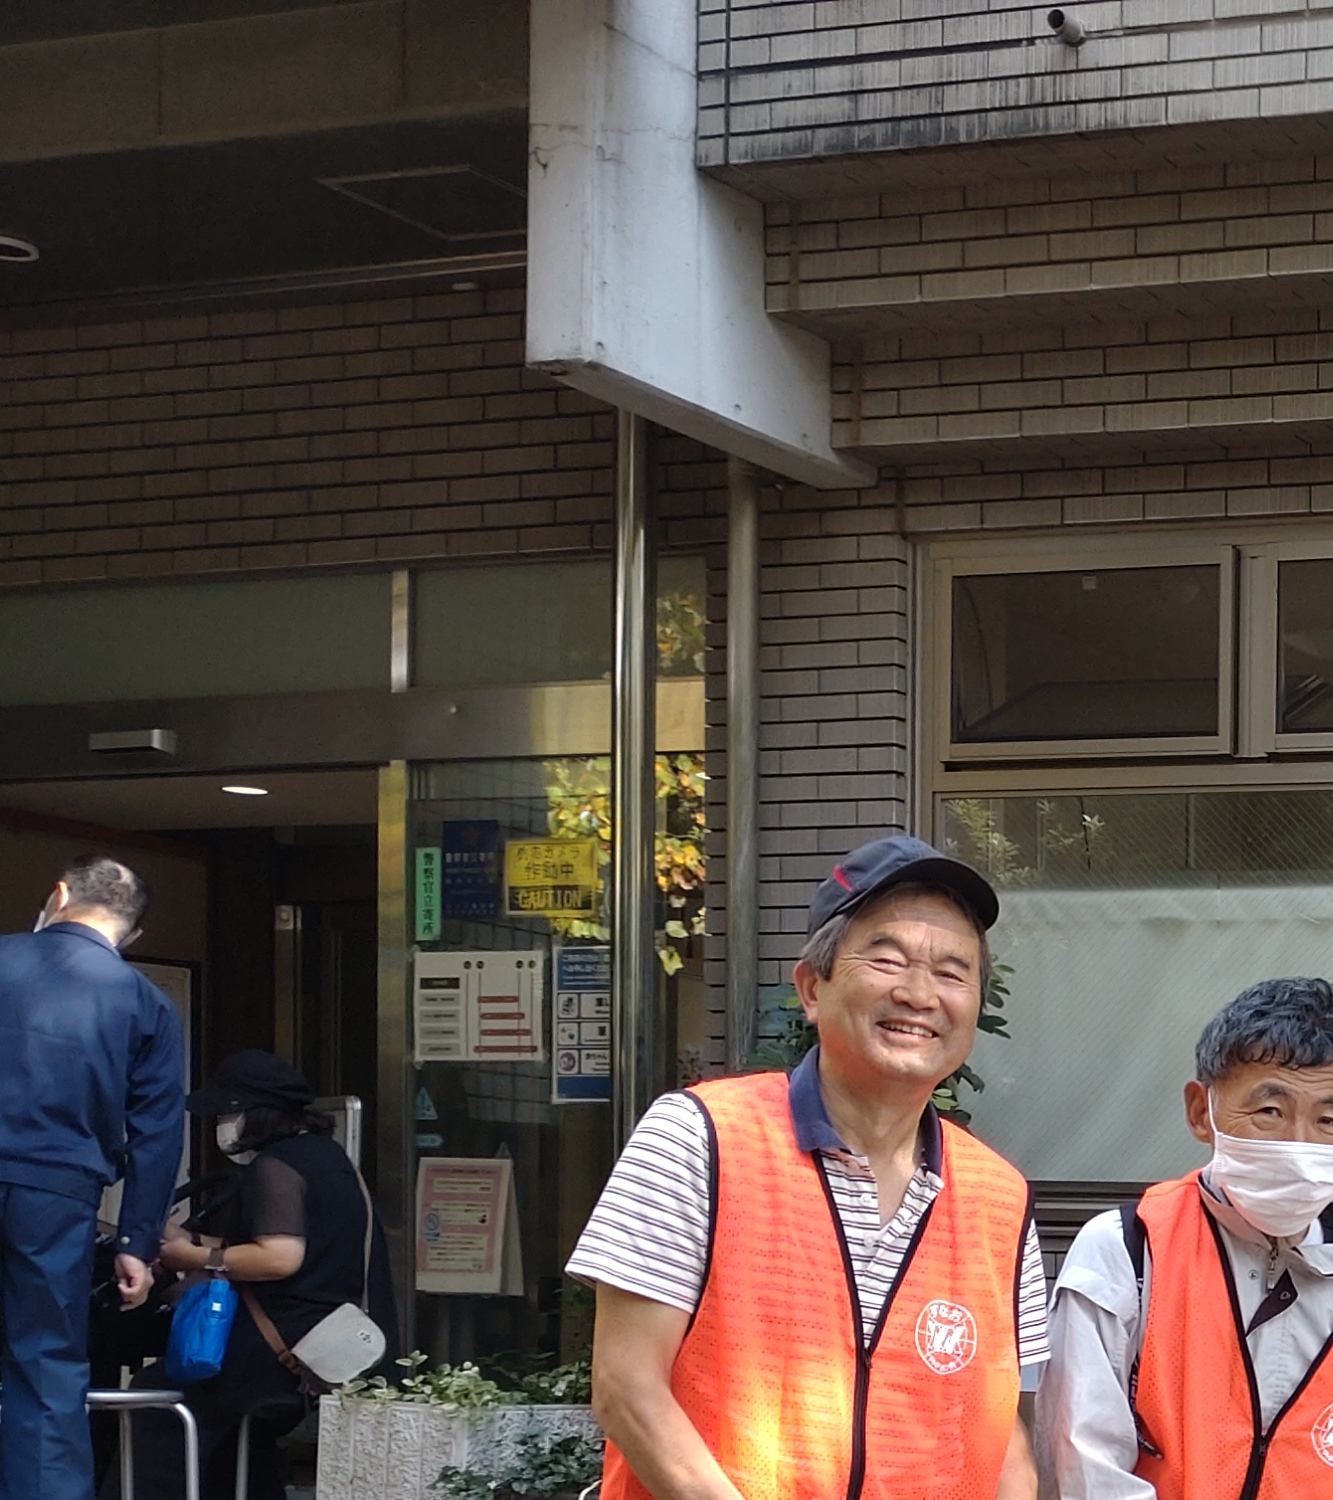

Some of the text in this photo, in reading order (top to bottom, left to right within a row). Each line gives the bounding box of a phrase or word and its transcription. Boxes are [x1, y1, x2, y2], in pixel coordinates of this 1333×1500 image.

[524, 861, 574, 880] 作動中
[422, 852, 435, 935] 警察官立寄所
[517, 889, 582, 908] CAUTION
[929, 1304, 963, 1322] すなお
